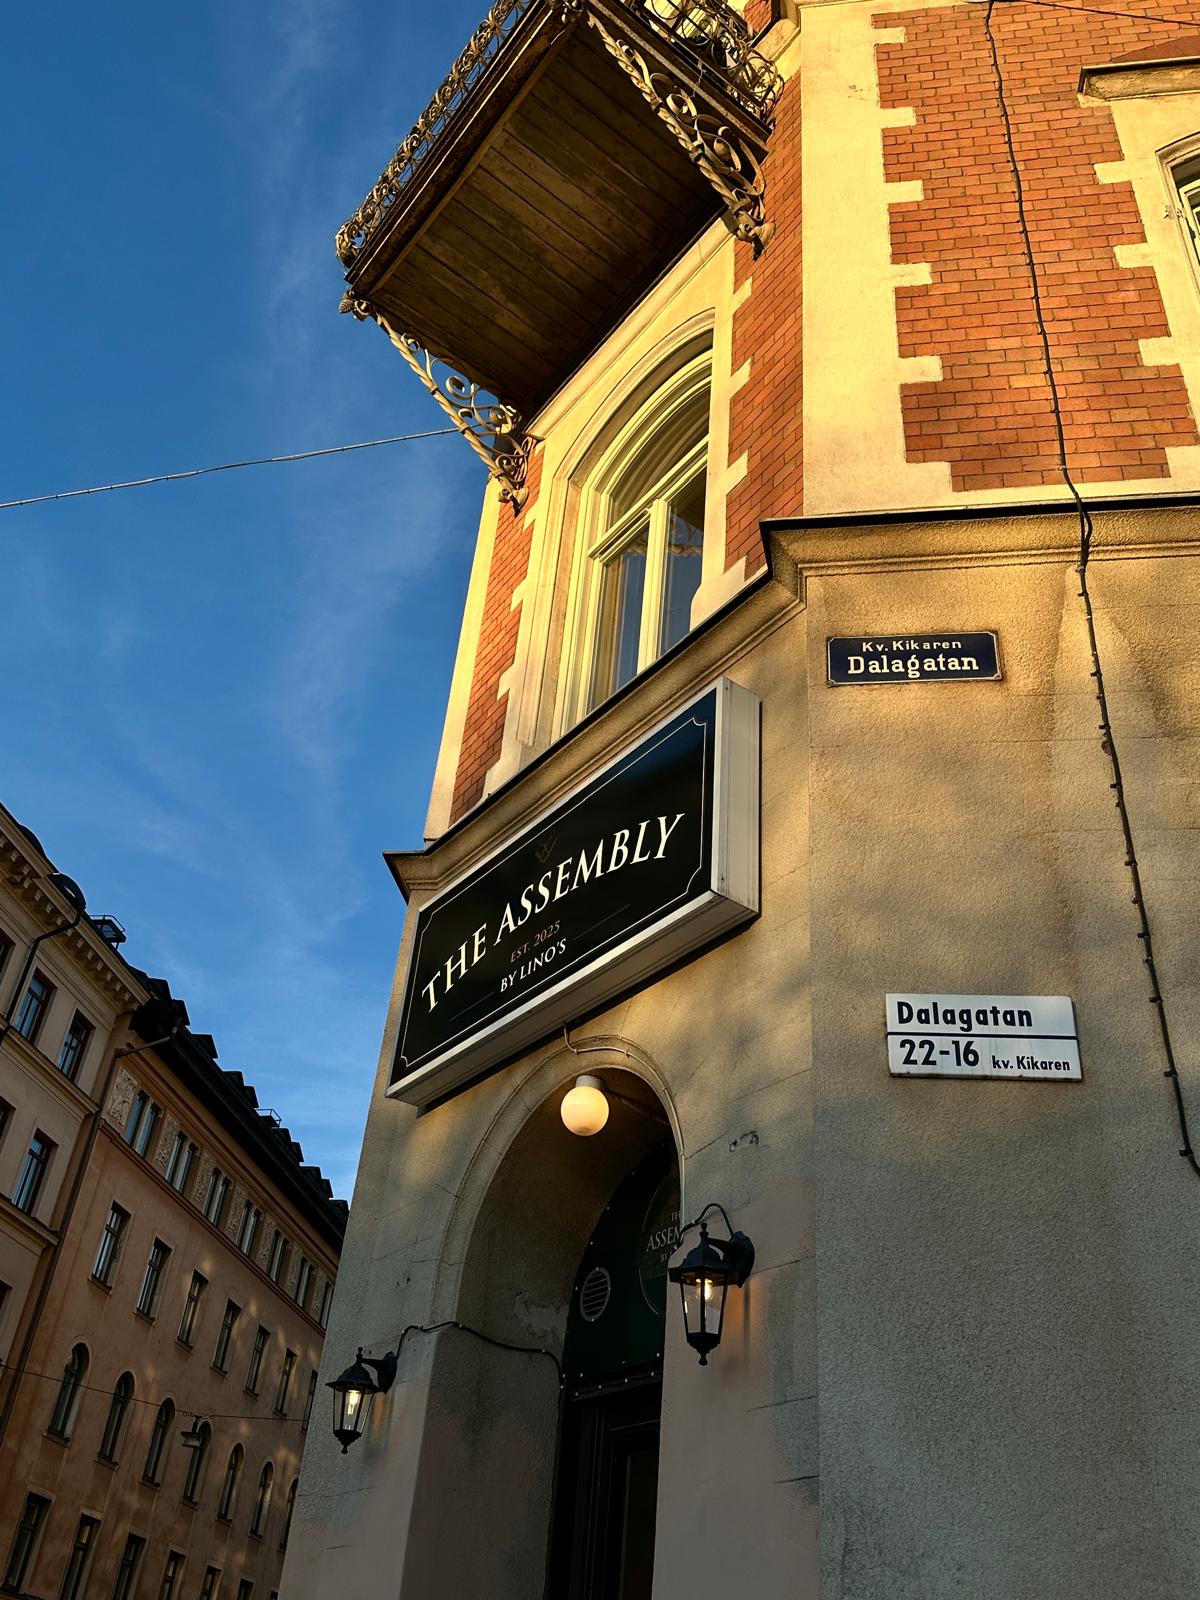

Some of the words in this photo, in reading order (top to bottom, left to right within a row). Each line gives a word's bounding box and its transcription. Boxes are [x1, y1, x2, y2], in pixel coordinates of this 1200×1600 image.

[862, 641, 888, 652] Kv.
[892, 639, 962, 651] Kikaren
[847, 653, 979, 679] Dalagatan
[421, 922, 488, 1013] THE
[494, 812, 685, 946] ASSEMBLY
[510, 942, 531, 963] EST.
[533, 920, 561, 947] 2025
[500, 970, 518, 993] BY
[520, 938, 567, 980] LINO'S
[896, 1001, 1033, 1032] Dalagatan
[899, 1038, 980, 1067] 22-16
[991, 1055, 1014, 1070] kv.
[1015, 1055, 1071, 1071] Kikaren
